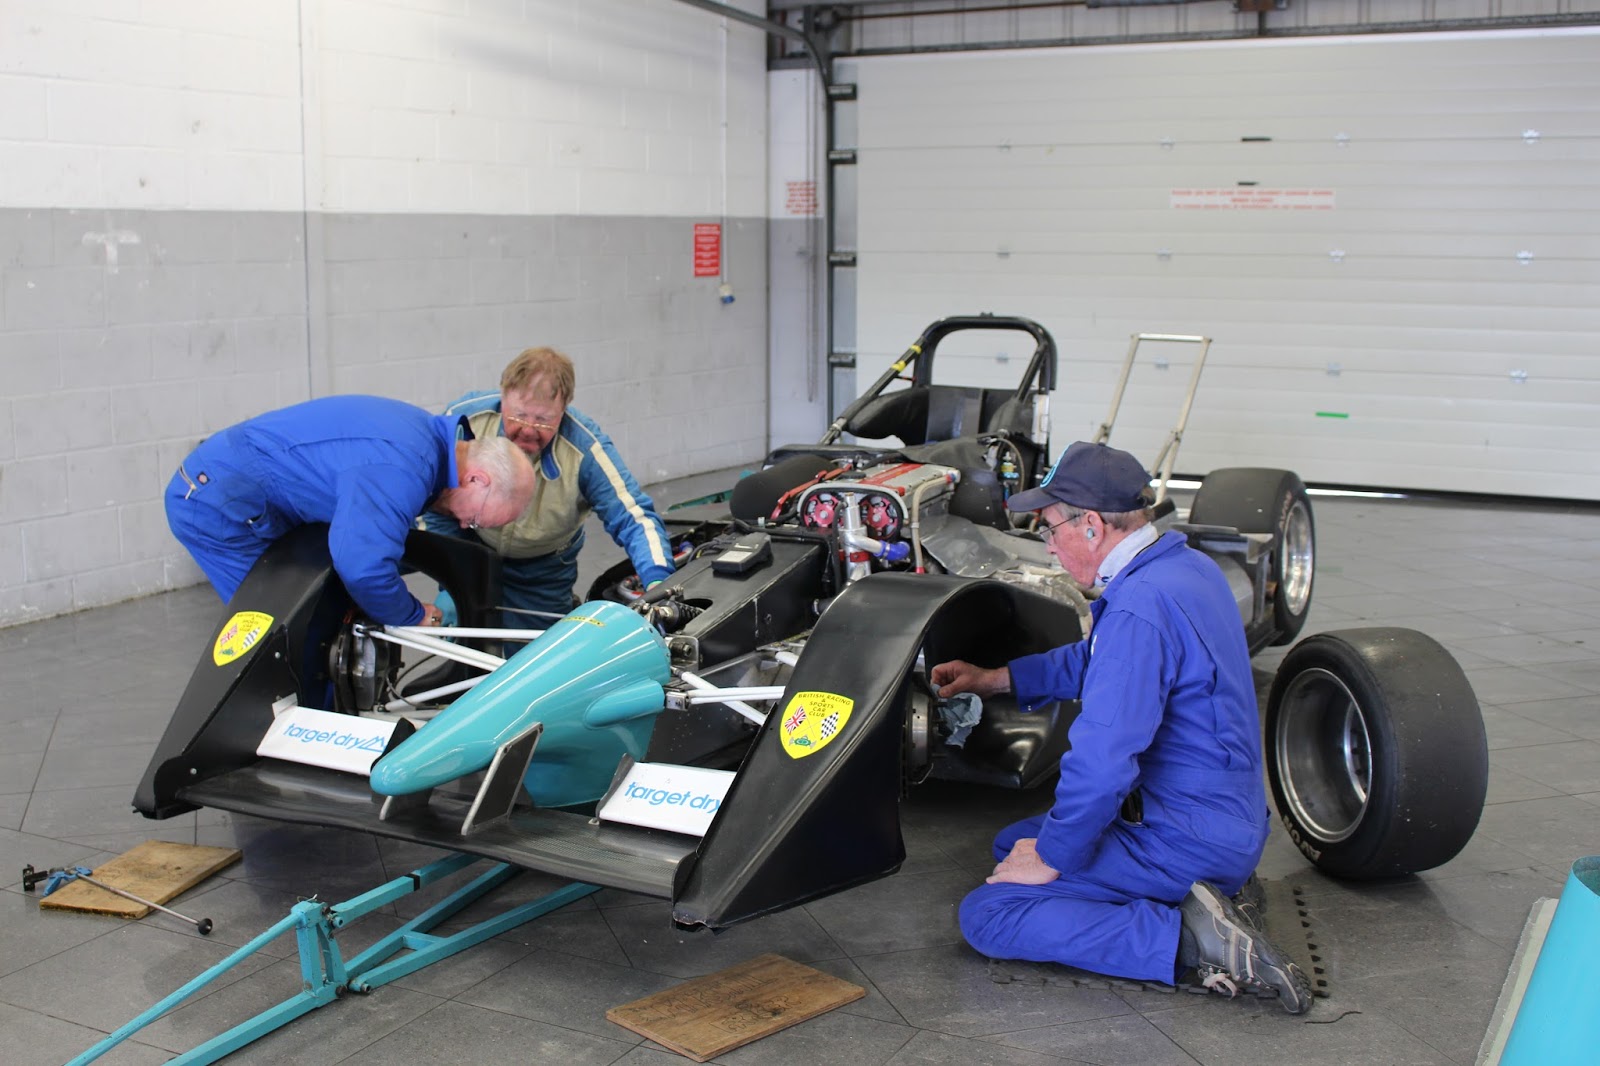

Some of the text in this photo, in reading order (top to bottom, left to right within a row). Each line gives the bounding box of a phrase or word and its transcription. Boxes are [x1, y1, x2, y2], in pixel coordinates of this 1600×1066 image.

[809, 701, 834, 709] SPORTS
[826, 694, 851, 706] RACING
[283, 722, 367, 750] target dry
[624, 781, 722, 814] target dry
